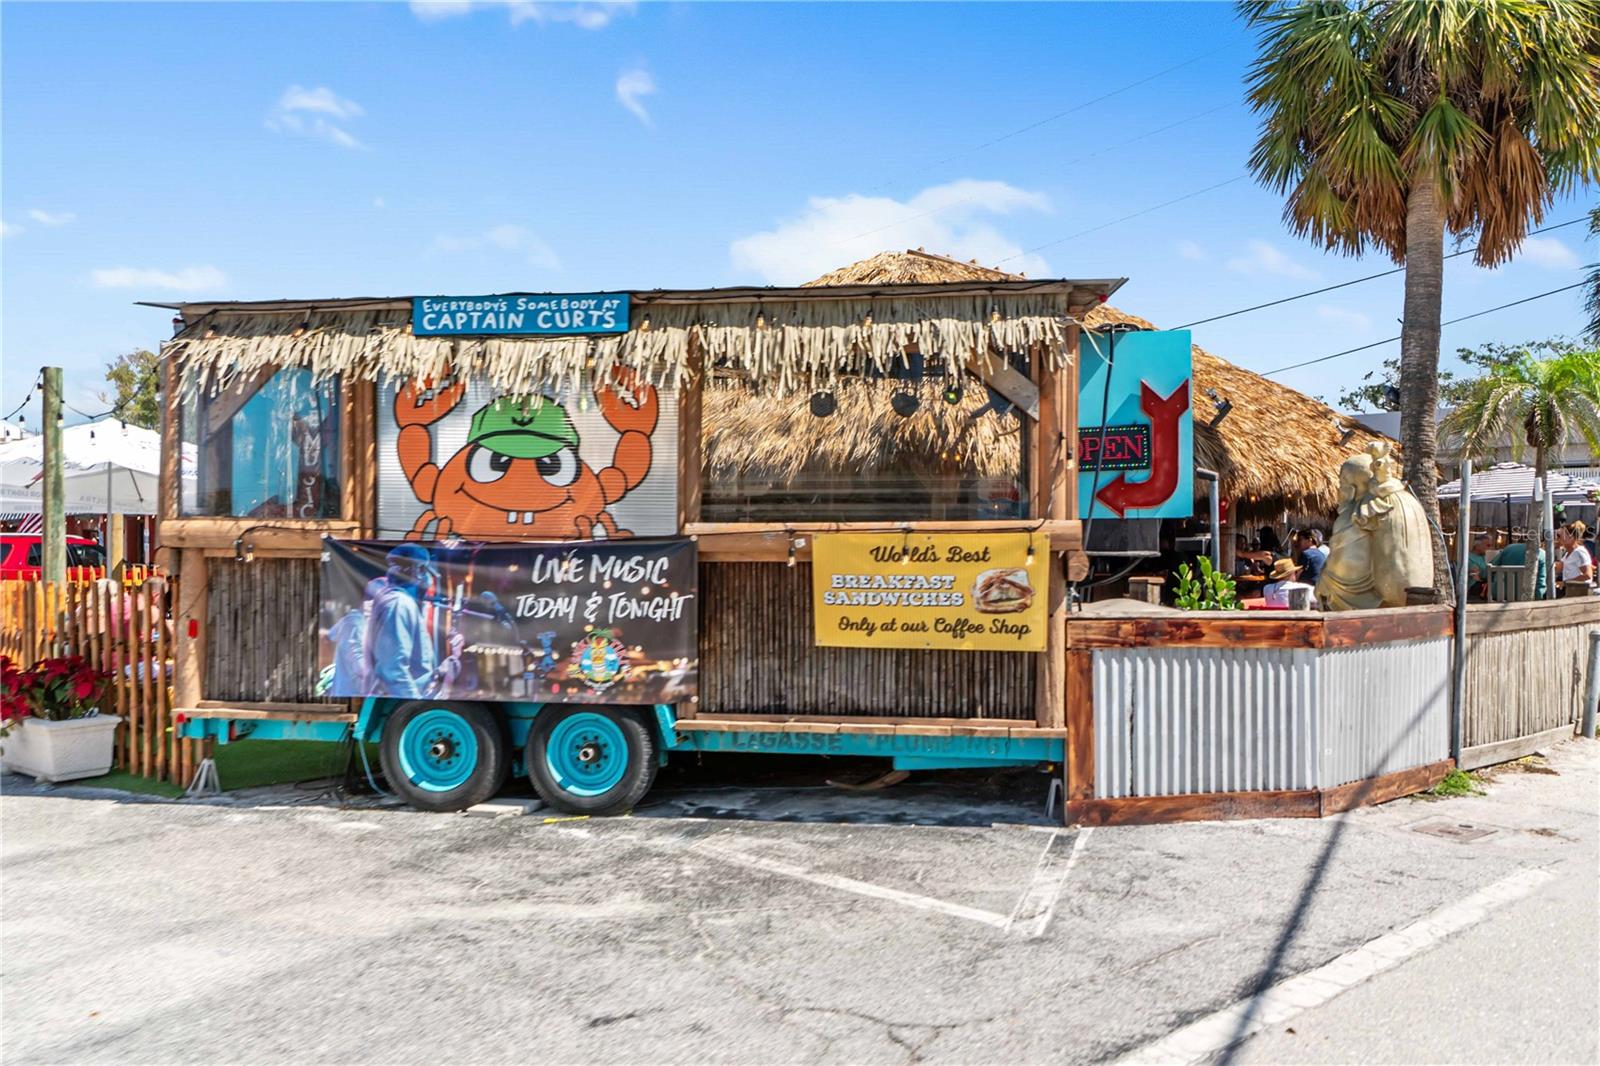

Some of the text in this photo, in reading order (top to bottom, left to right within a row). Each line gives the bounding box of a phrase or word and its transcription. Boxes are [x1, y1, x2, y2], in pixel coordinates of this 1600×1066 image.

[516, 298, 597, 311] SOMEBODY
[603, 299, 621, 311] AT
[422, 312, 524, 330] CAPTAIN
[1078, 435, 1144, 461] PEN
[869, 544, 992, 563] Wold's Best
[532, 549, 669, 585] LIVE MUSIC
[831, 574, 957, 590] BREAKFAST
[516, 591, 695, 624] TODAY & TONIGHT
[823, 591, 965, 607] SANDWICHES
[838, 616, 1032, 640] Only at our Coffee Shop
